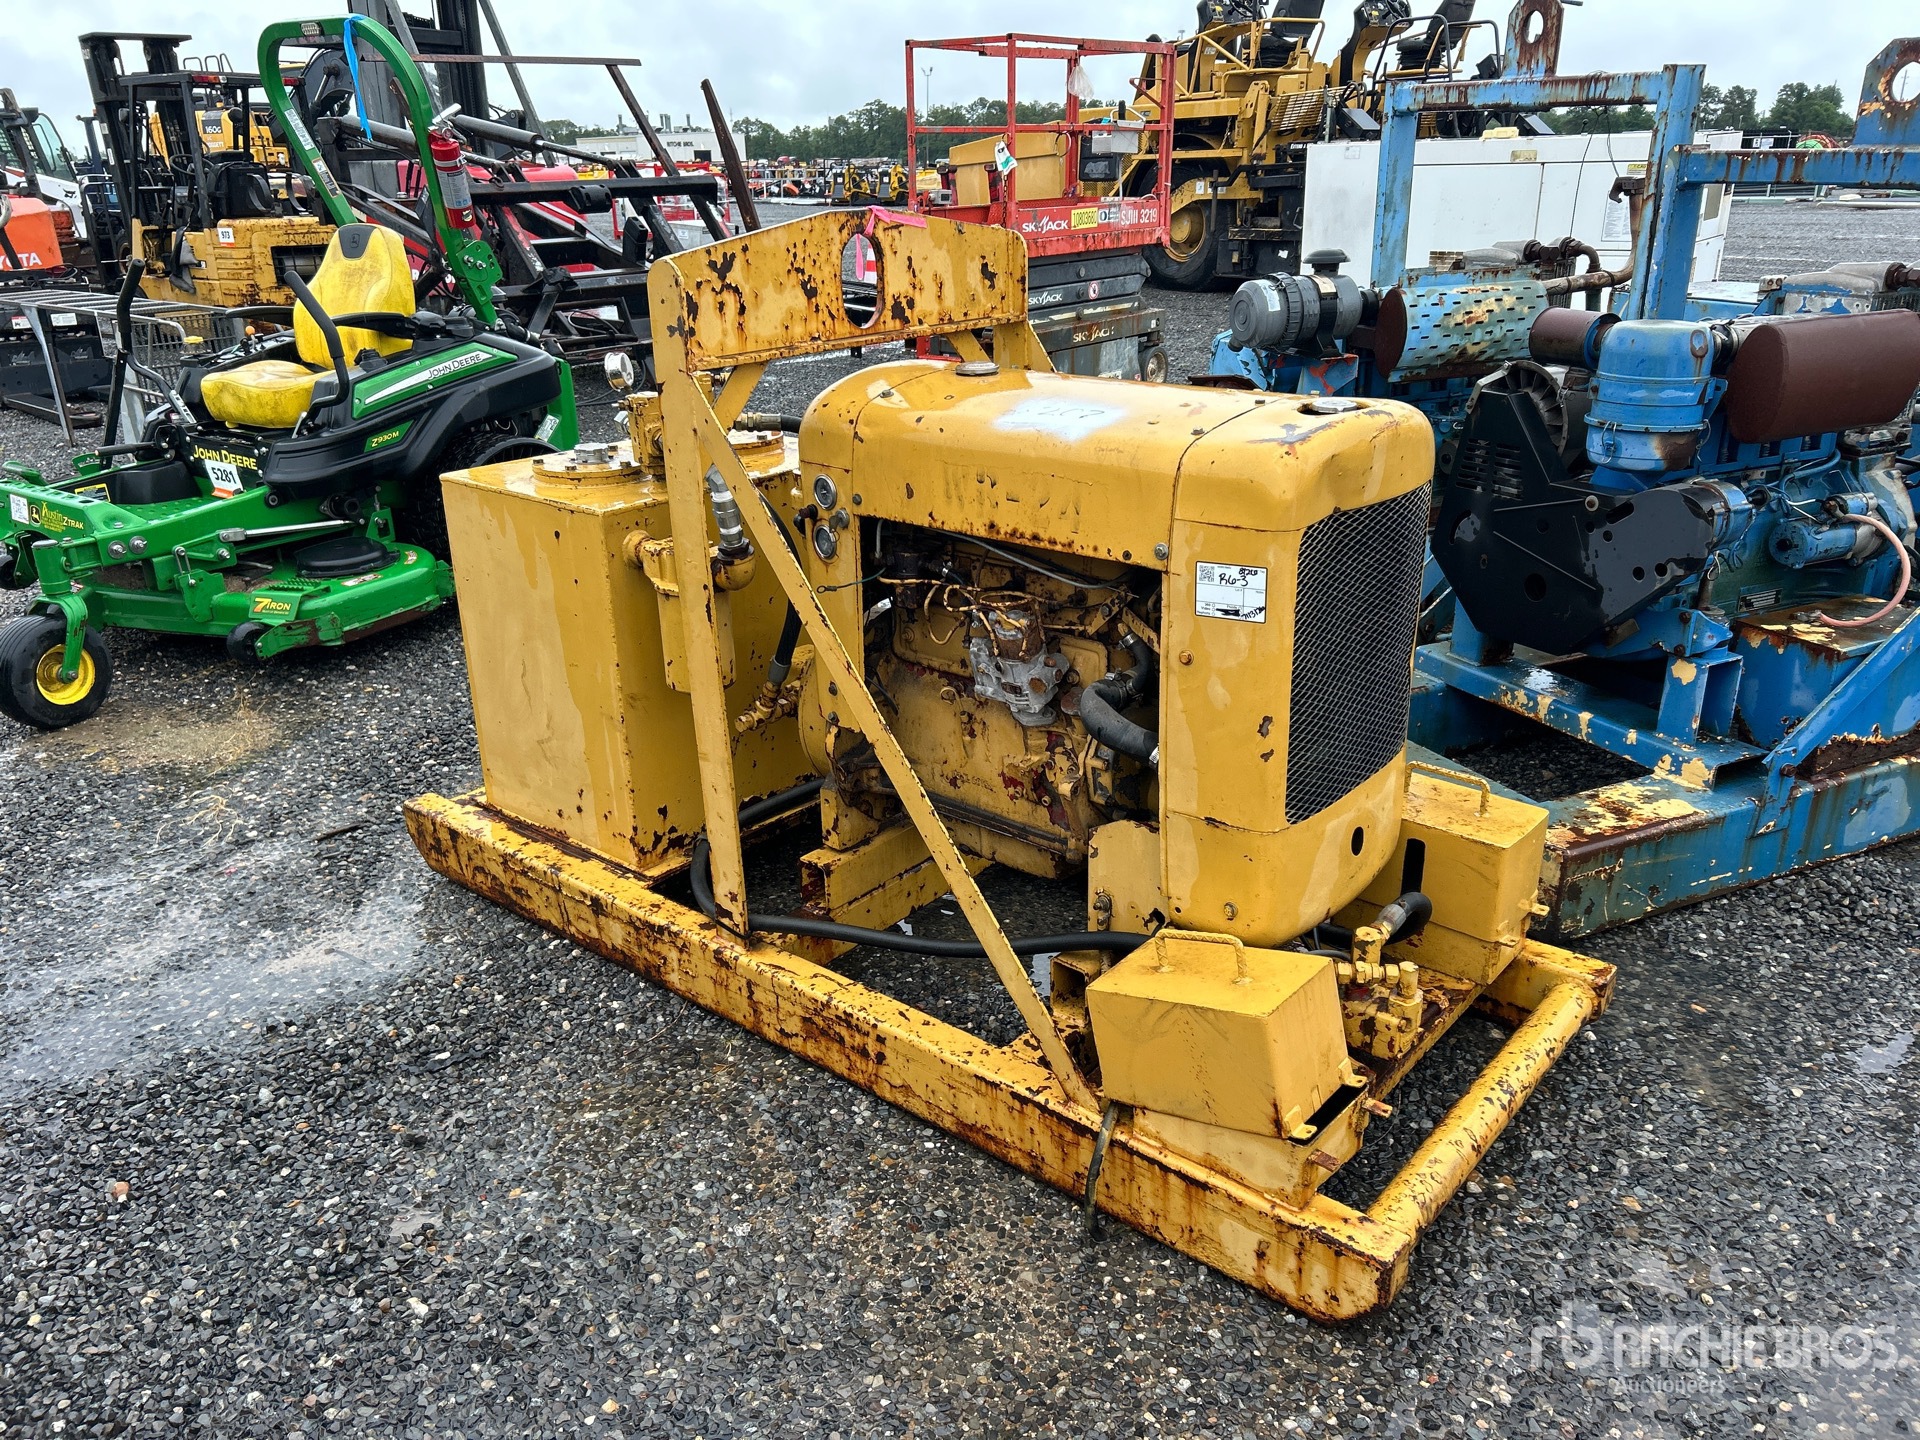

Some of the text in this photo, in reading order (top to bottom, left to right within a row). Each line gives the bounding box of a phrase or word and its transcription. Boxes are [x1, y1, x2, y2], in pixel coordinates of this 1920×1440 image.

[1140, 207, 1158, 224] 3219
[220, 230, 231, 240] 973
[1028, 291, 1063, 306] SKYJACK
[428, 353, 482, 379] JOHN DEERE
[371, 430, 400, 448] Z930M
[193, 444, 258, 471] JOHN DEERE
[210, 466, 237, 485] 5281
